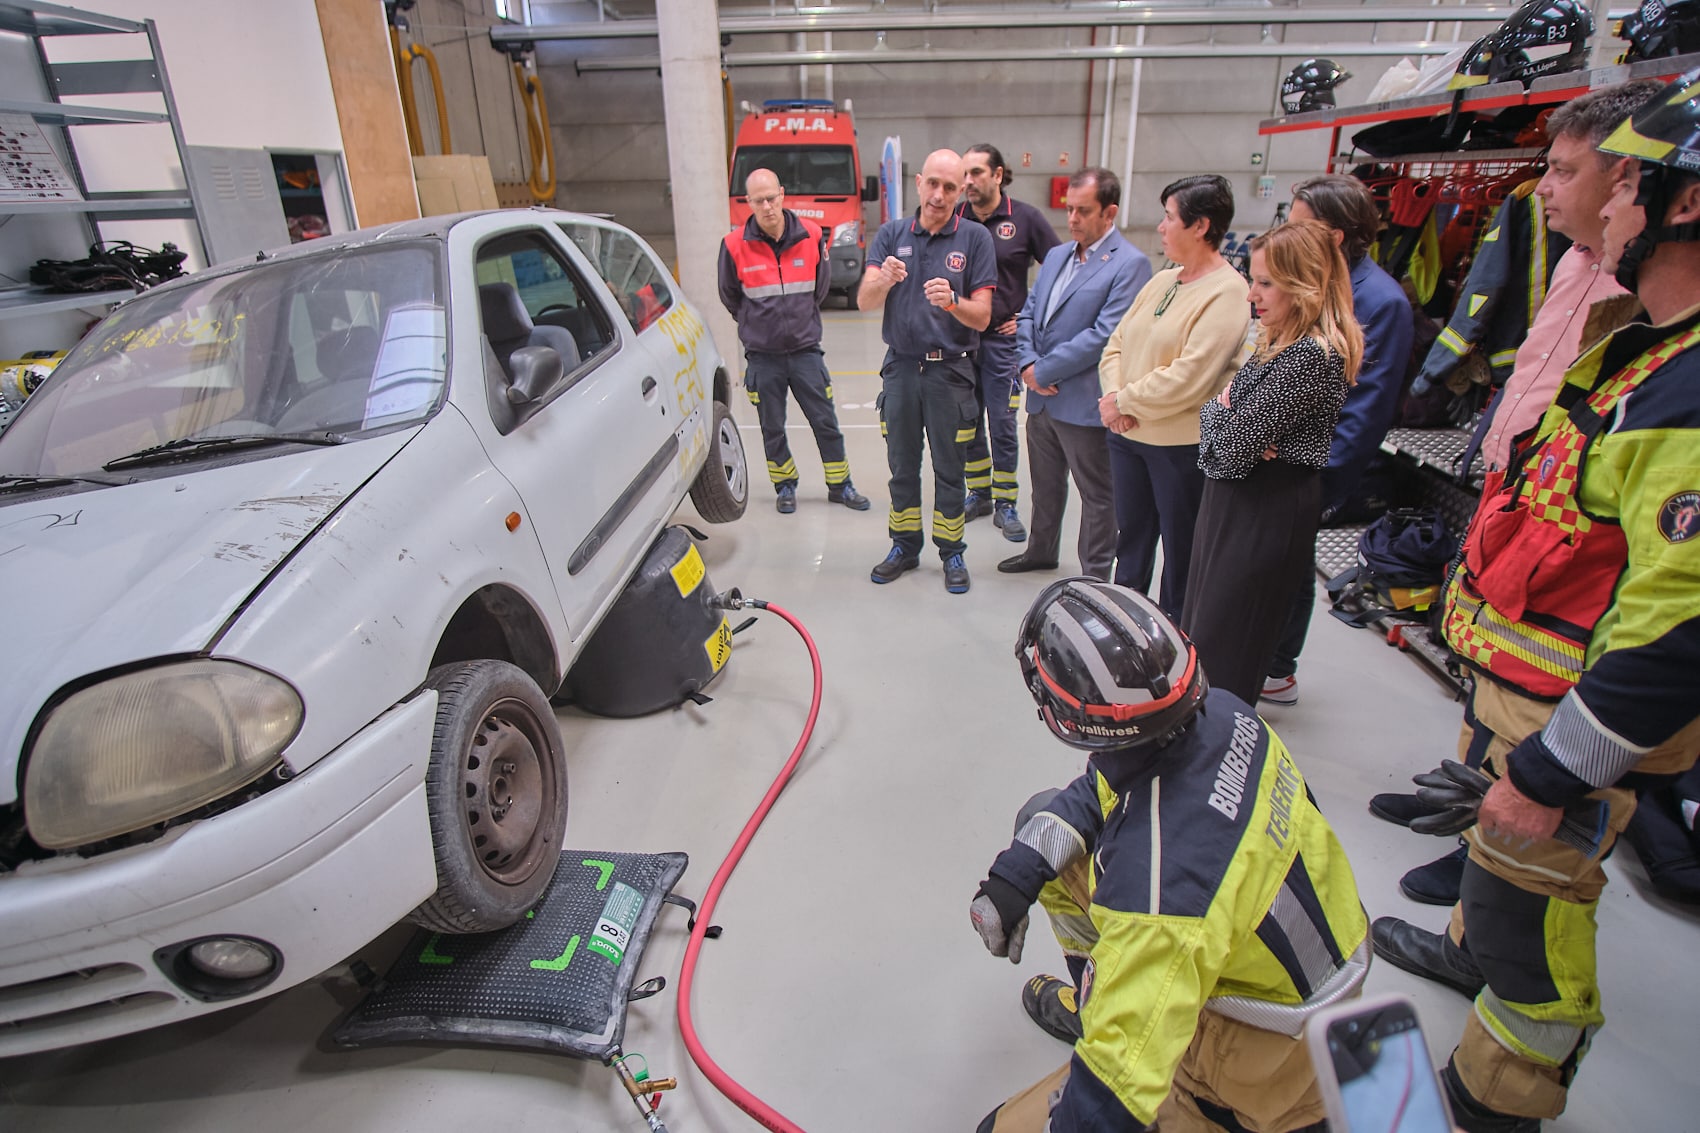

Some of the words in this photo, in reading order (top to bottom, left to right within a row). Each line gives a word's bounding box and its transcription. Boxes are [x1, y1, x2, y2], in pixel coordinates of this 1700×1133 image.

[1548, 24, 1567, 40] B-3
[1538, 60, 1558, 72] López
[765, 117, 834, 132] P.M.A.
[1077, 724, 1140, 737] vallfirest
[1208, 711, 1260, 821] BOMBEROS
[1265, 753, 1301, 850] TENERIF
[600, 924, 618, 937] 8
[617, 930, 627, 945] FLAT
